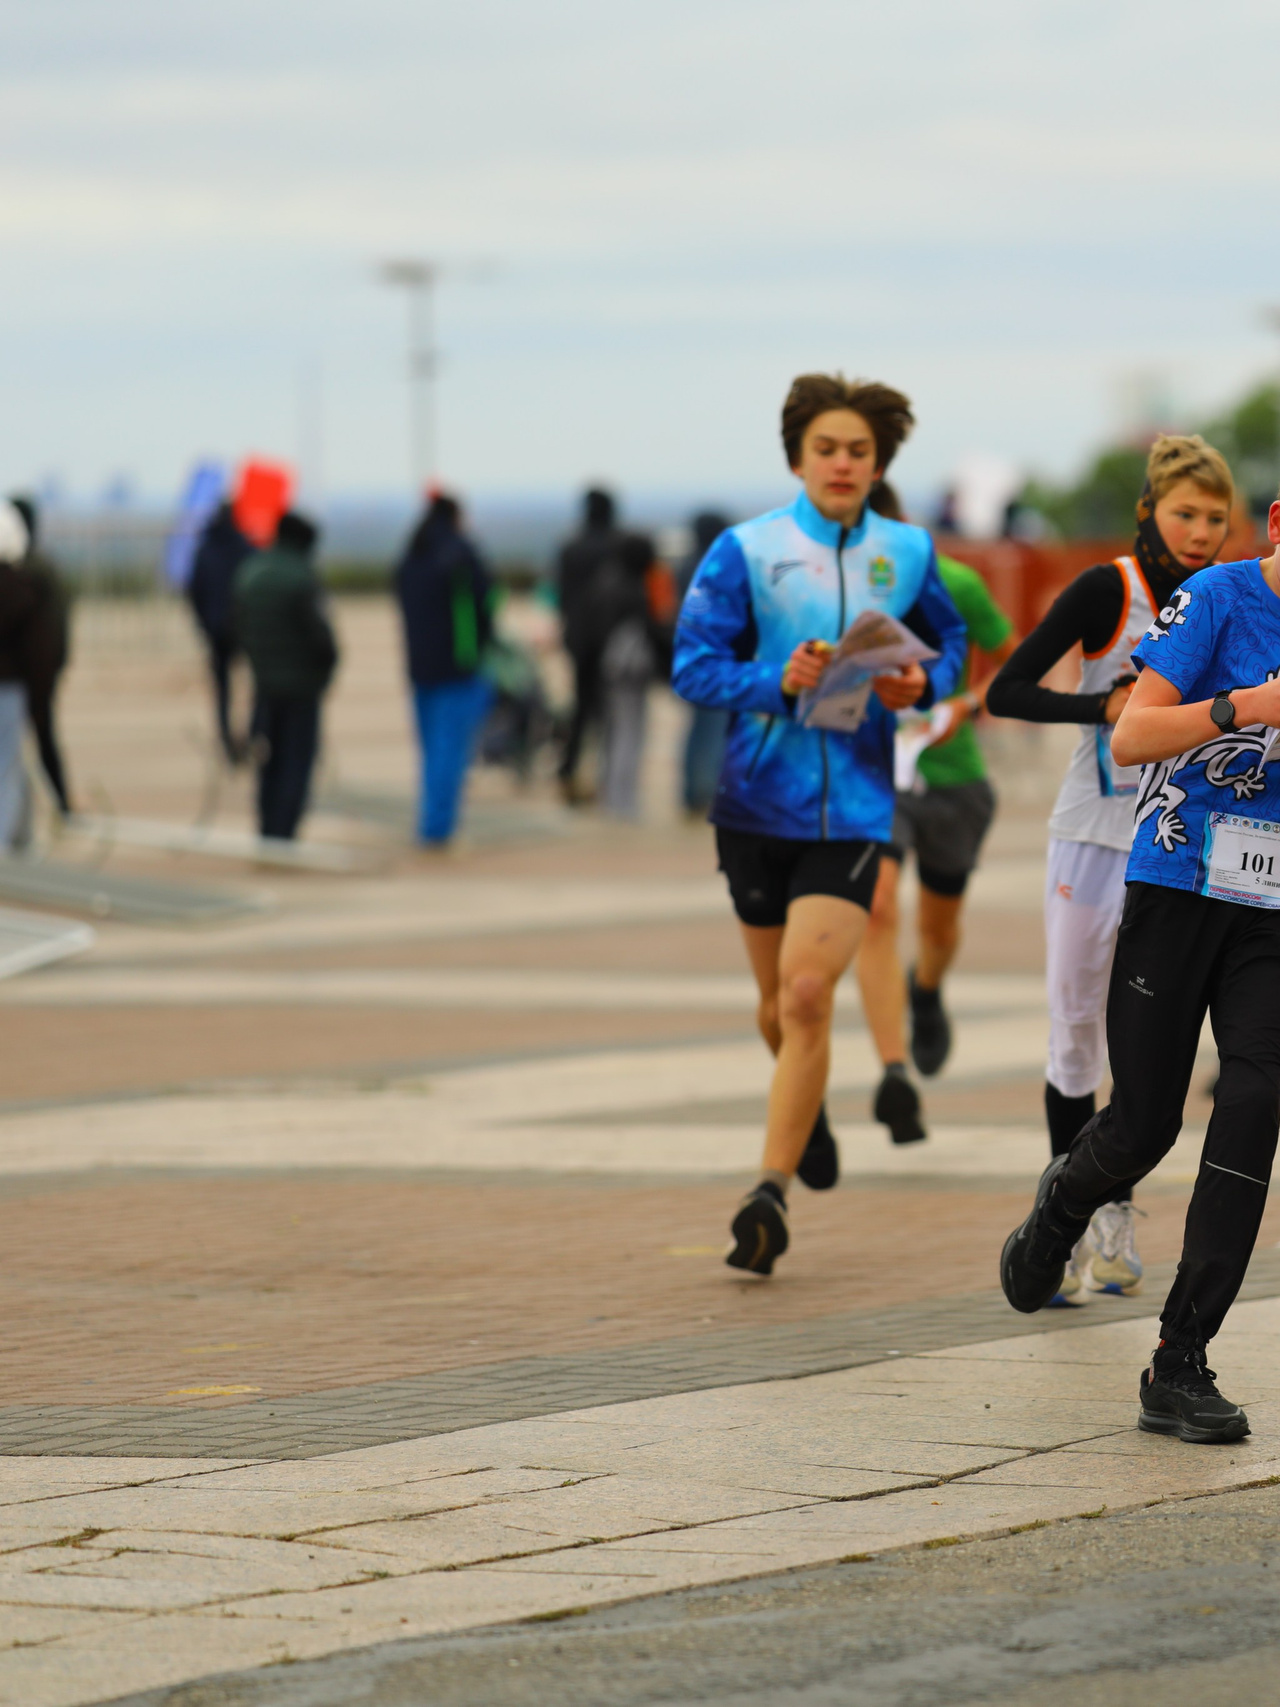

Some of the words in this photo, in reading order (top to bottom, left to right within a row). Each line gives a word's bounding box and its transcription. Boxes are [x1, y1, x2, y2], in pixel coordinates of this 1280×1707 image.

[1240, 851, 1275, 876] 101
[1255, 877, 1260, 885] 5
[1209, 886, 1241, 897] ПЕРВЕНСТВО
